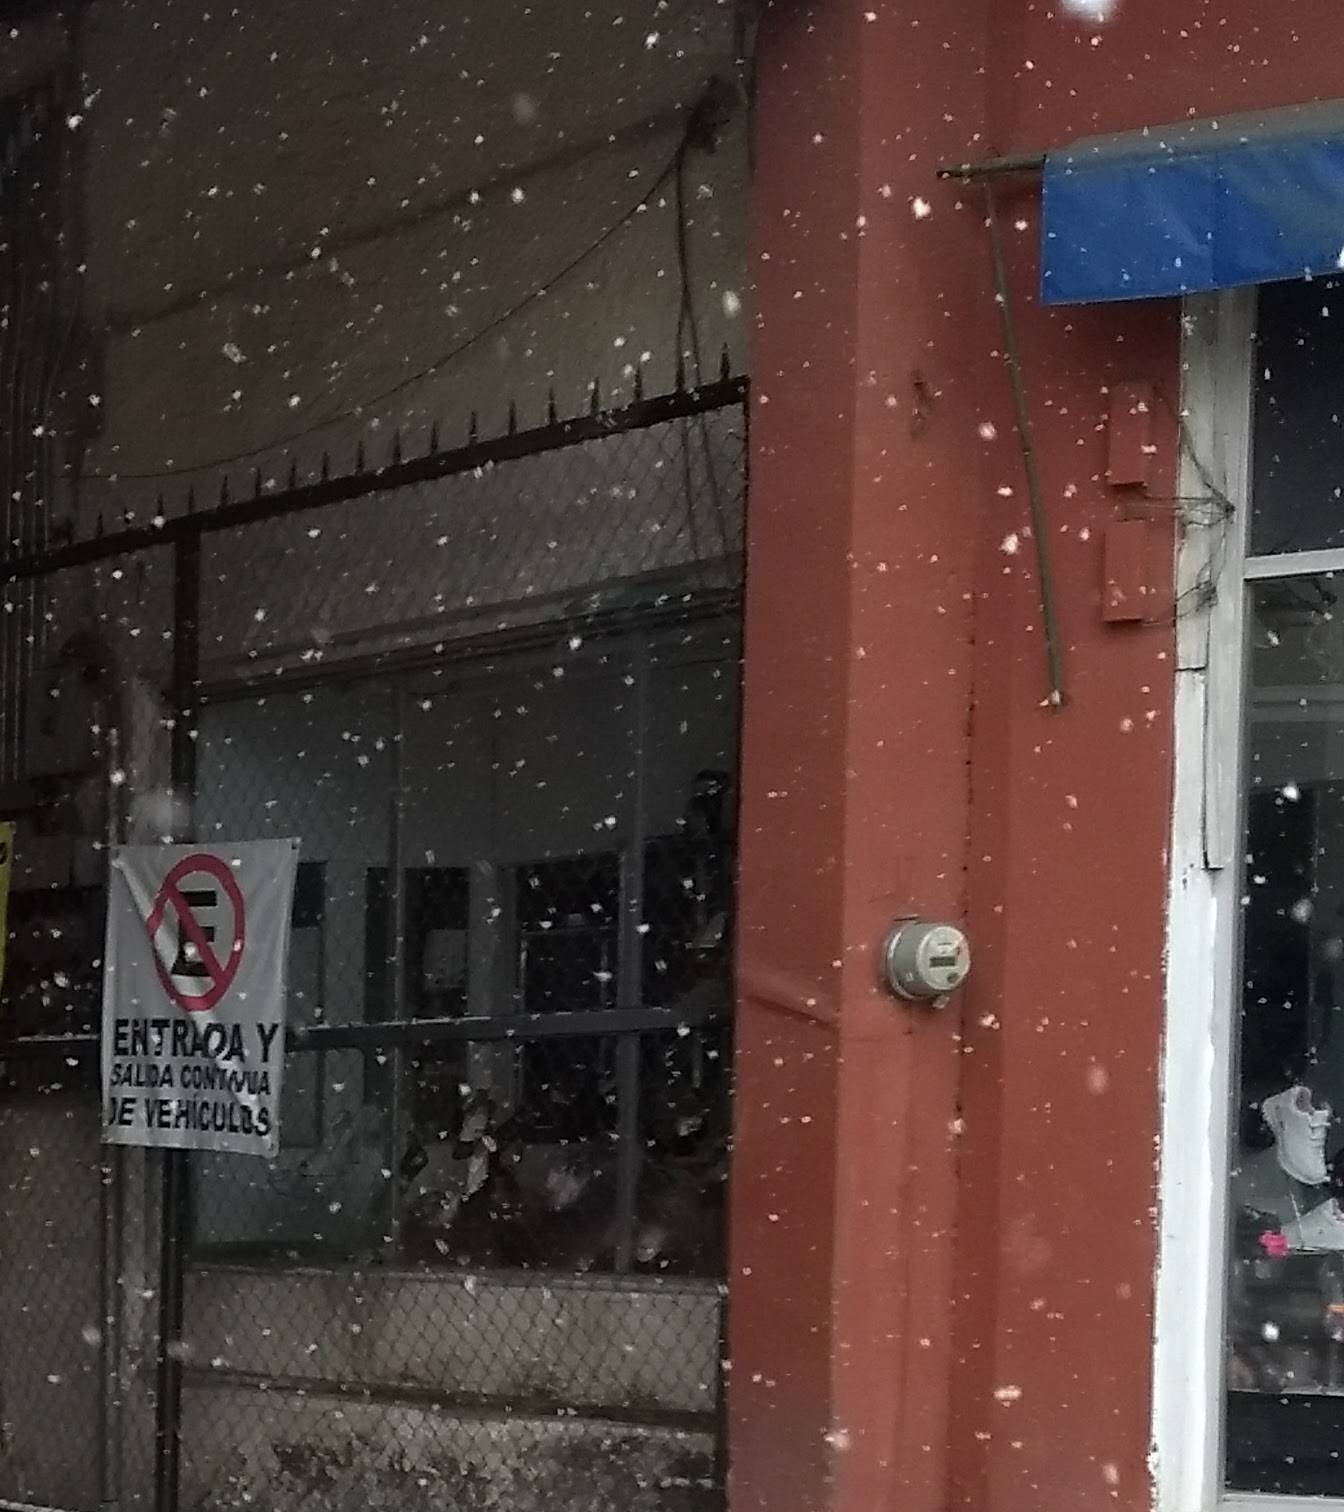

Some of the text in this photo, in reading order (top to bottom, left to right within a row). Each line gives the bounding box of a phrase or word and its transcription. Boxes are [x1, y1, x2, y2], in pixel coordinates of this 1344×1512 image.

[113, 1018, 279, 1063] ENTRADA Y
[111, 1062, 271, 1096] SALDA CONTNUA
